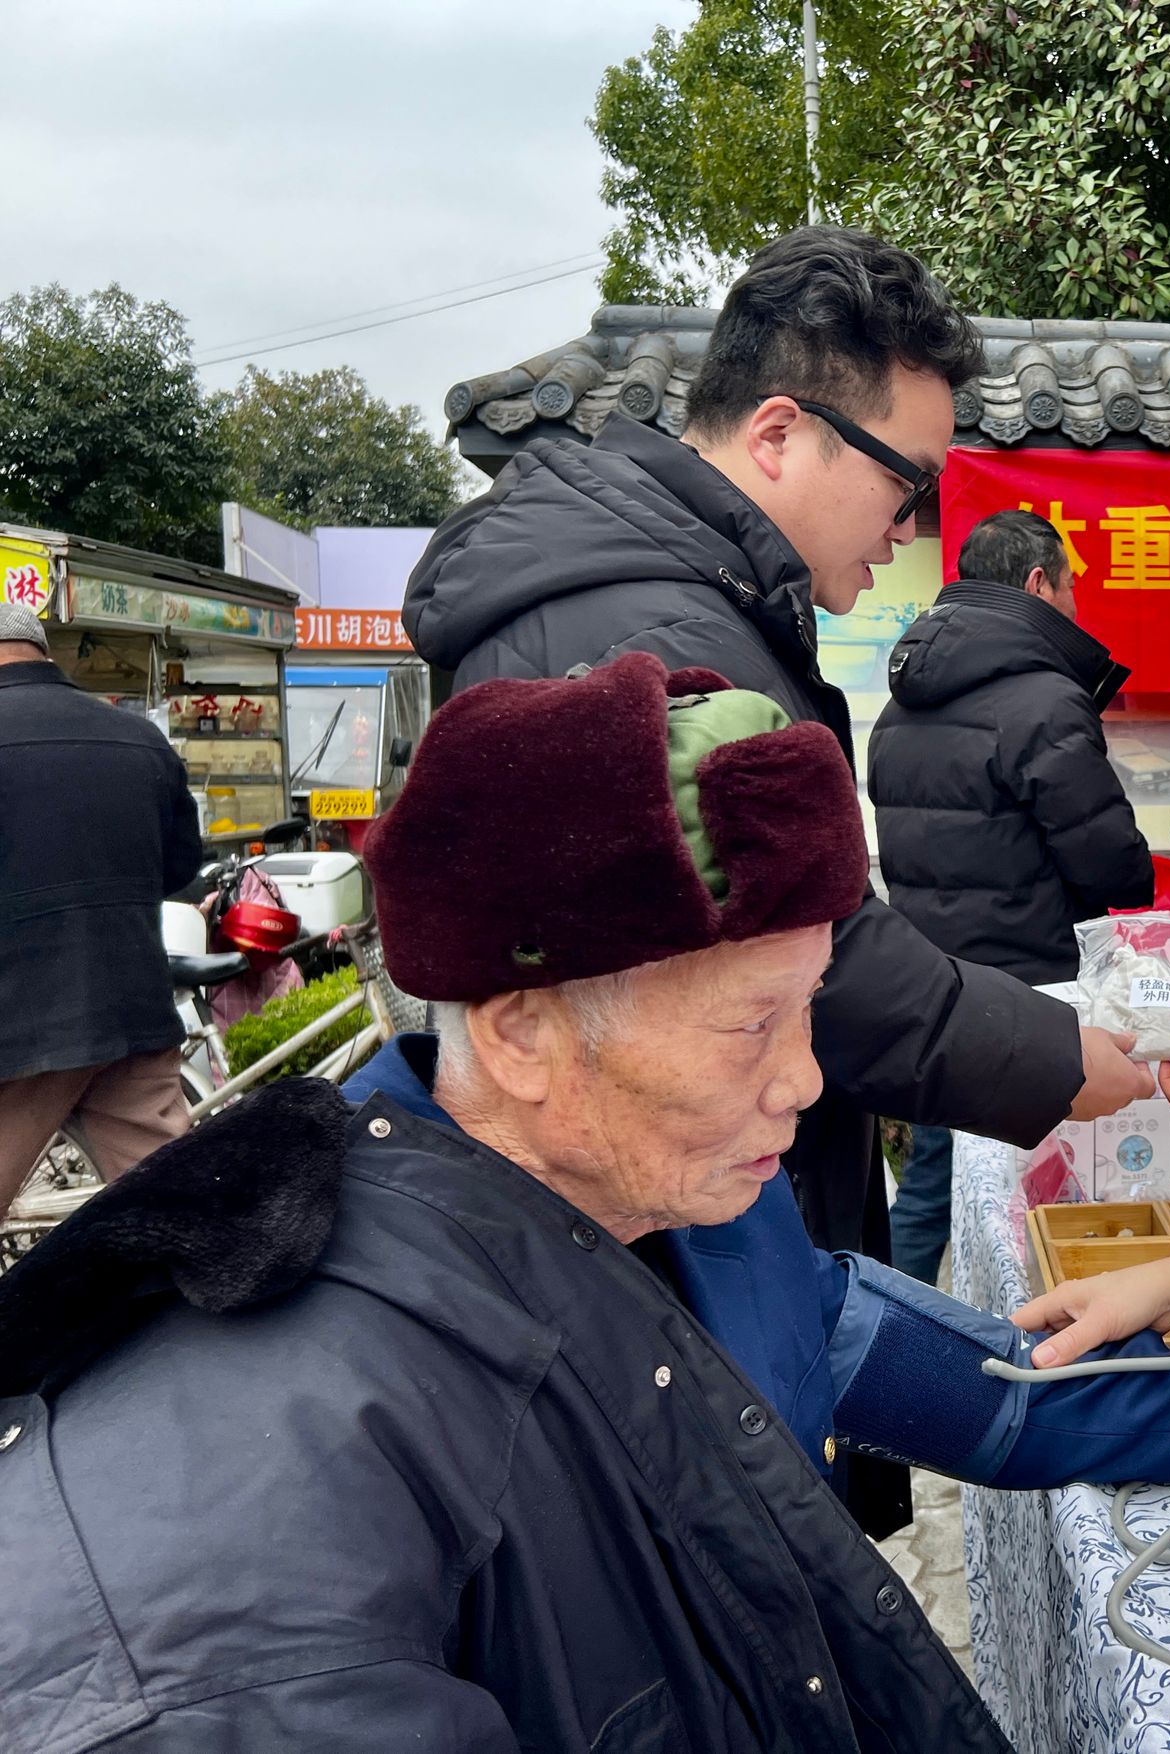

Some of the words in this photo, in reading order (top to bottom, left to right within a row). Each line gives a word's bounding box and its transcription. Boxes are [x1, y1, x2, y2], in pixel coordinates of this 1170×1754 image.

[6, 566, 46, 607] 淋
[295, 613, 412, 647] 川胡泡
[1143, 990, 1170, 1002] 外用
